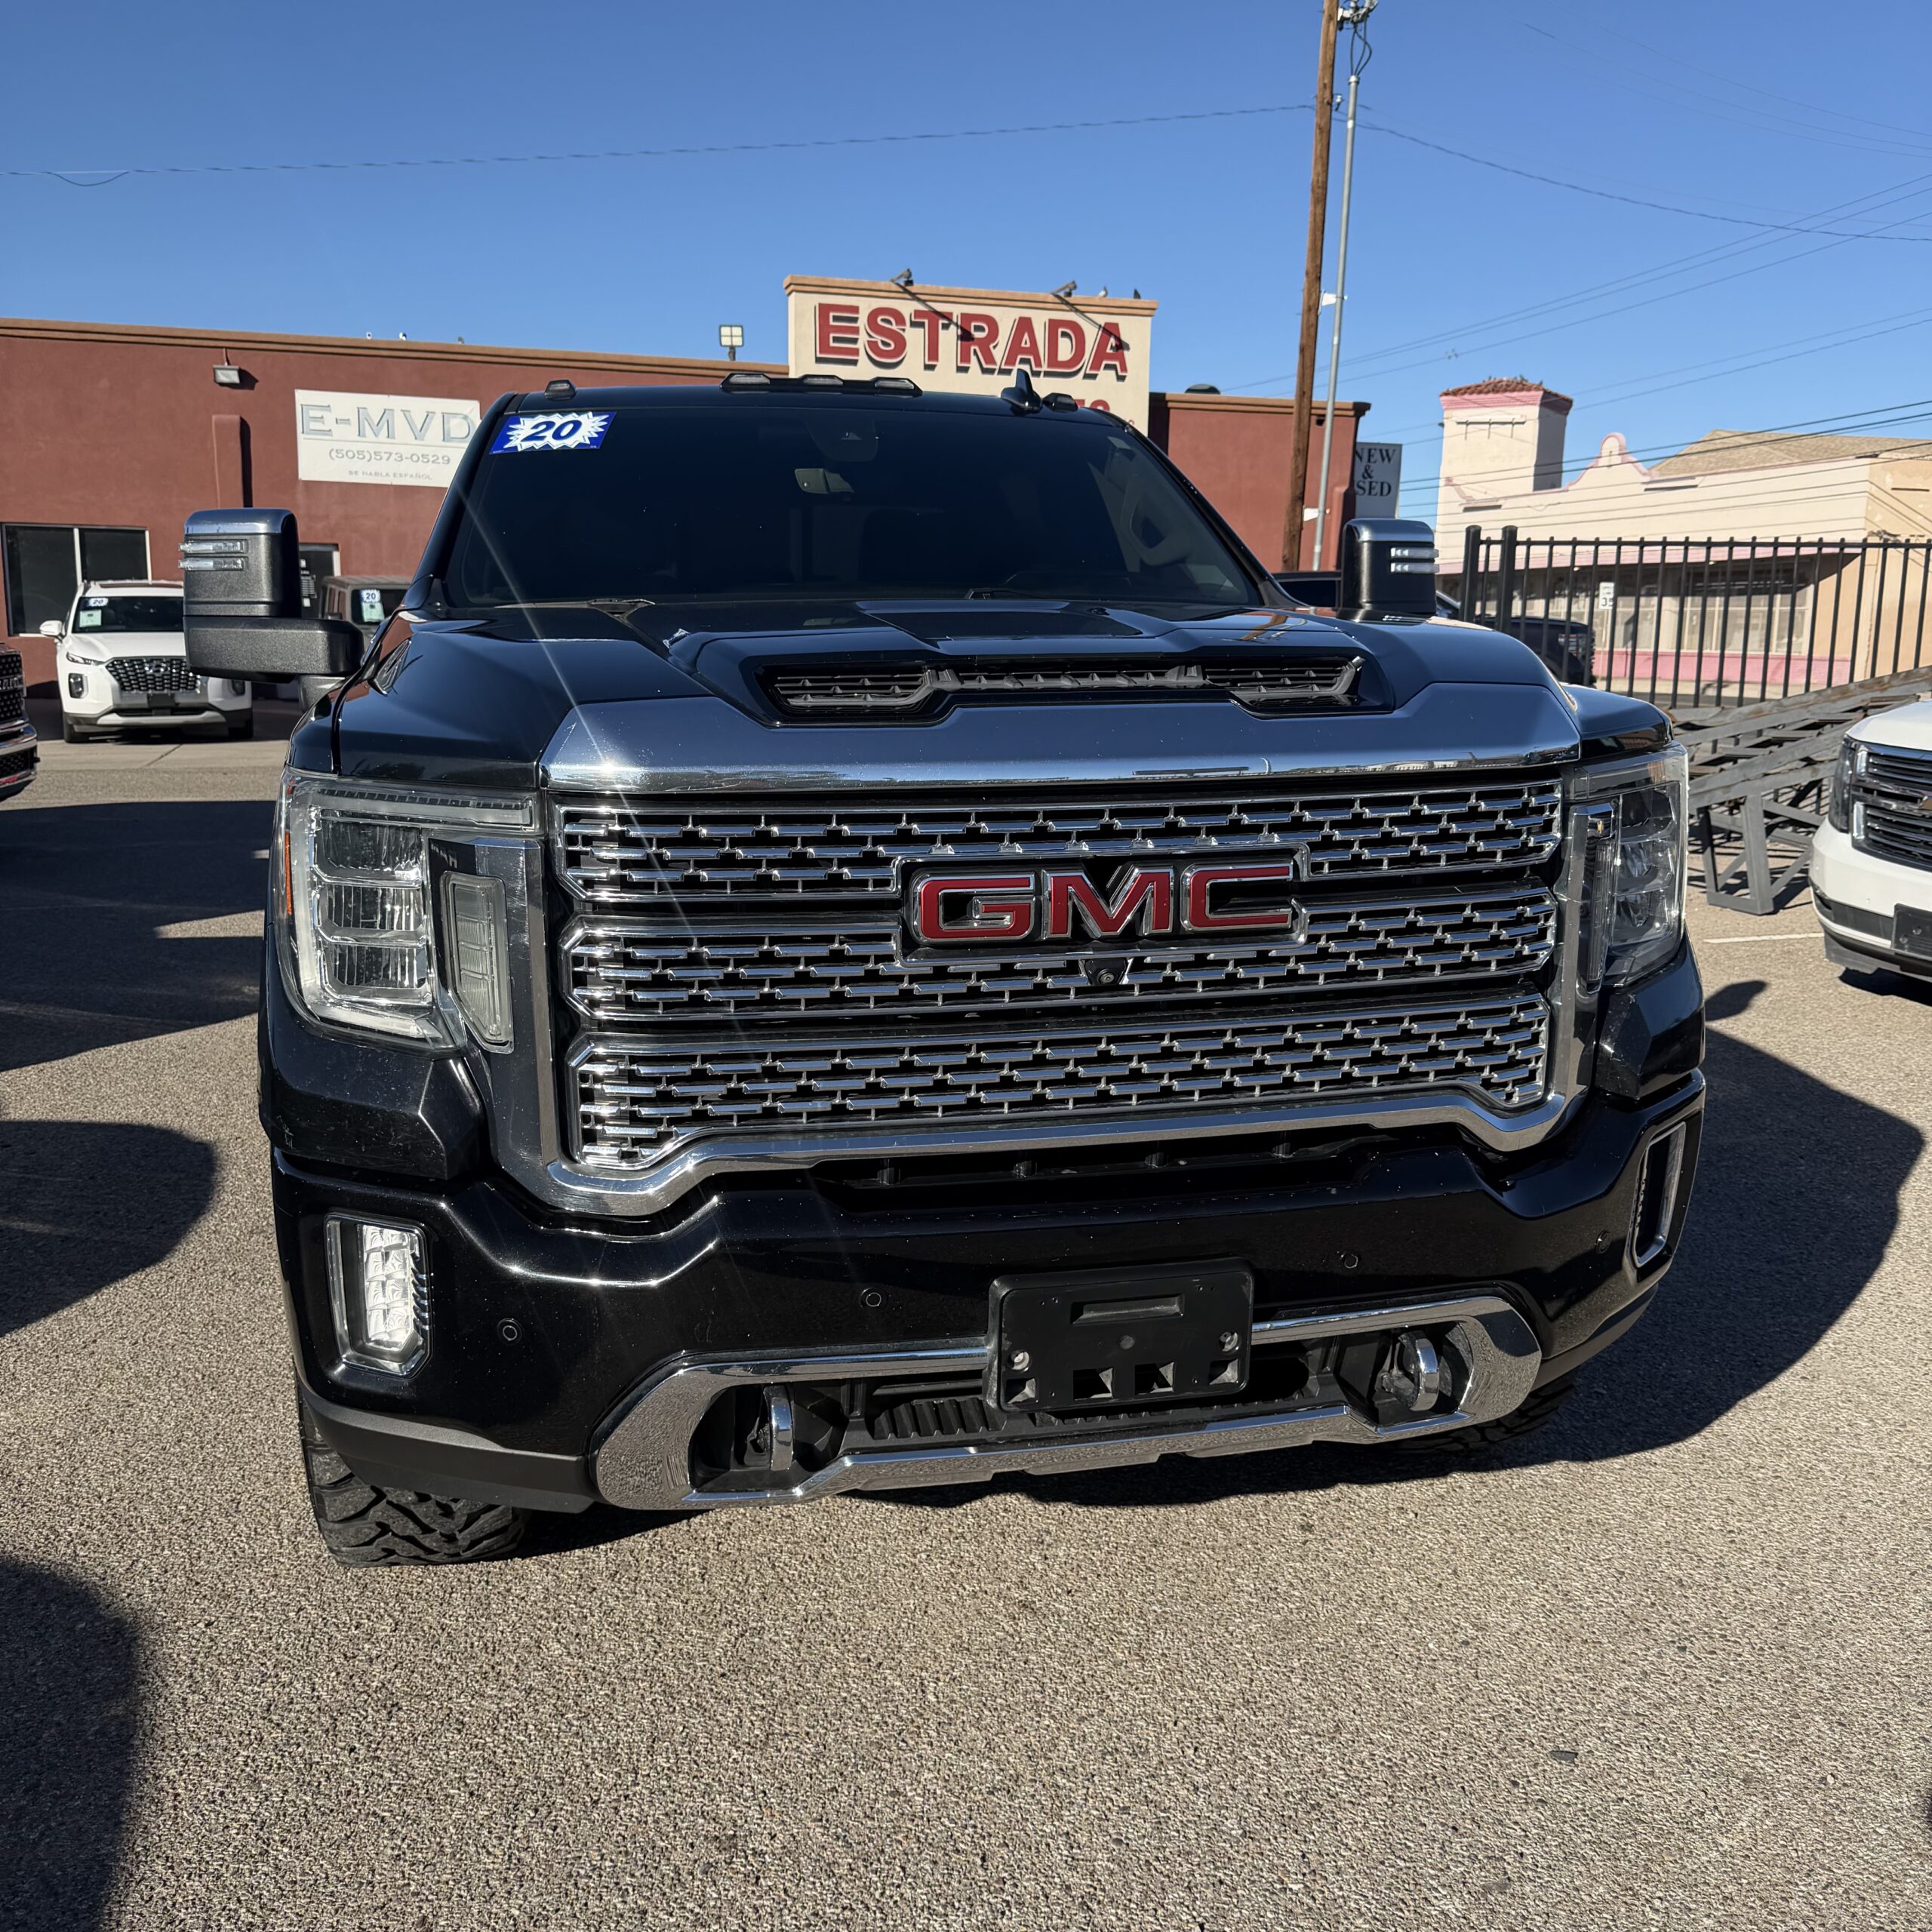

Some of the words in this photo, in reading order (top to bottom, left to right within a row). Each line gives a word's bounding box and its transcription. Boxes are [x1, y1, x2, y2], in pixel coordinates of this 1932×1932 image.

[816, 303, 1129, 379] ESTRADA
[300, 404, 477, 443] E-MVD
[520, 419, 583, 442] 20
[328, 448, 451, 465] (505)573-0529
[1361, 464, 1374, 479] &
[1355, 480, 1392, 497] SED
[911, 863, 1294, 943] GMC
